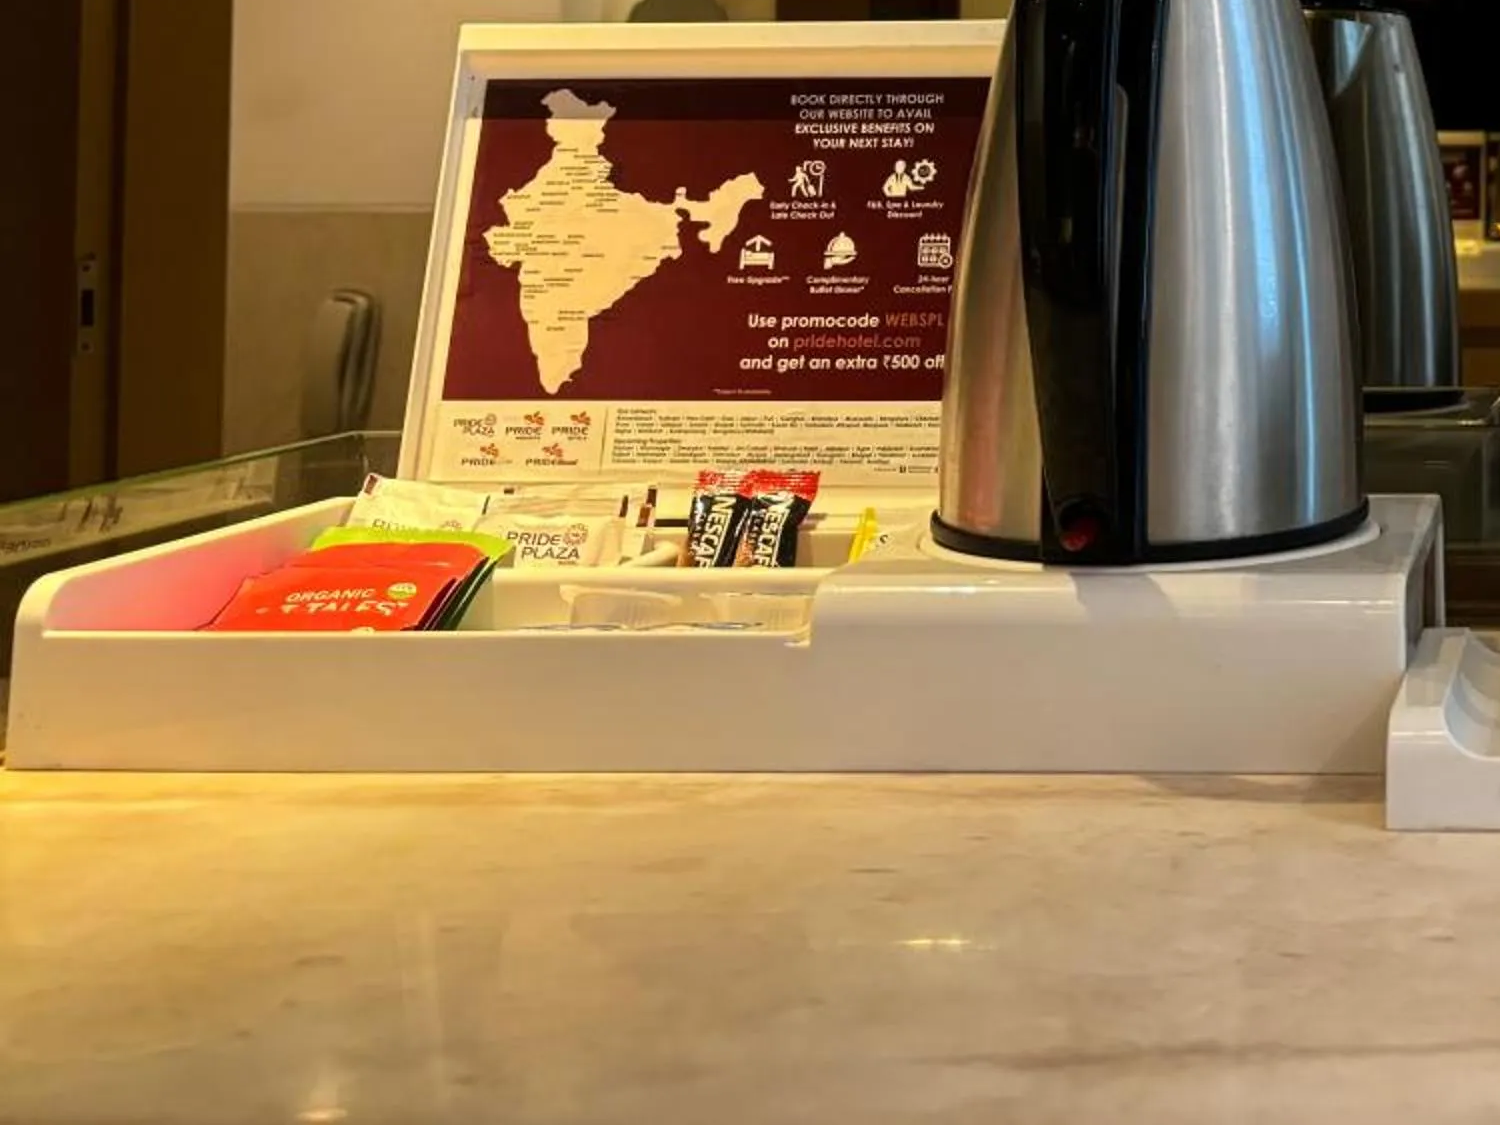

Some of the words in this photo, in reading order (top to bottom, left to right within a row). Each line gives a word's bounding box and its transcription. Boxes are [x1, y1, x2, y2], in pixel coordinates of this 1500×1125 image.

[790, 94, 826, 105] BOOK
[829, 94, 883, 105] DIRECTLY
[886, 93, 945, 104] THROUGH
[800, 109, 825, 119] OUR
[828, 109, 874, 119] WEBSITE
[878, 109, 893, 119] TO
[895, 108, 932, 119] AVAIL
[795, 123, 857, 134] EXCLUSIVE
[861, 123, 911, 134] BENEFITS
[915, 123, 935, 133] ON
[813, 138, 845, 148] YOUR
[849, 138, 878, 148] NEXT
[881, 137, 914, 148] STAY!
[790, 211, 817, 220] Check
[819, 211, 835, 219] Out
[806, 276, 869, 286] Complimentary
[748, 313, 777, 328] Use
[781, 312, 880, 331] promocode
[768, 336, 789, 349] on
[793, 334, 921, 352] pridehotel.com
[739, 355, 773, 370] and
[777, 355, 805, 373] get
[809, 358, 831, 370] an
[835, 355, 877, 370] extra
[882, 355, 921, 370] ₹500
[924, 355, 945, 369] off
[505, 426, 542, 436] PRIDE
[552, 426, 589, 436] PRIDE
[694, 495, 738, 568] NESCAF
[753, 492, 797, 568] NESCAF
[506, 531, 562, 546] PRIDE
[521, 546, 580, 560] PLAZA
[285, 588, 376, 603] ORGANIC
